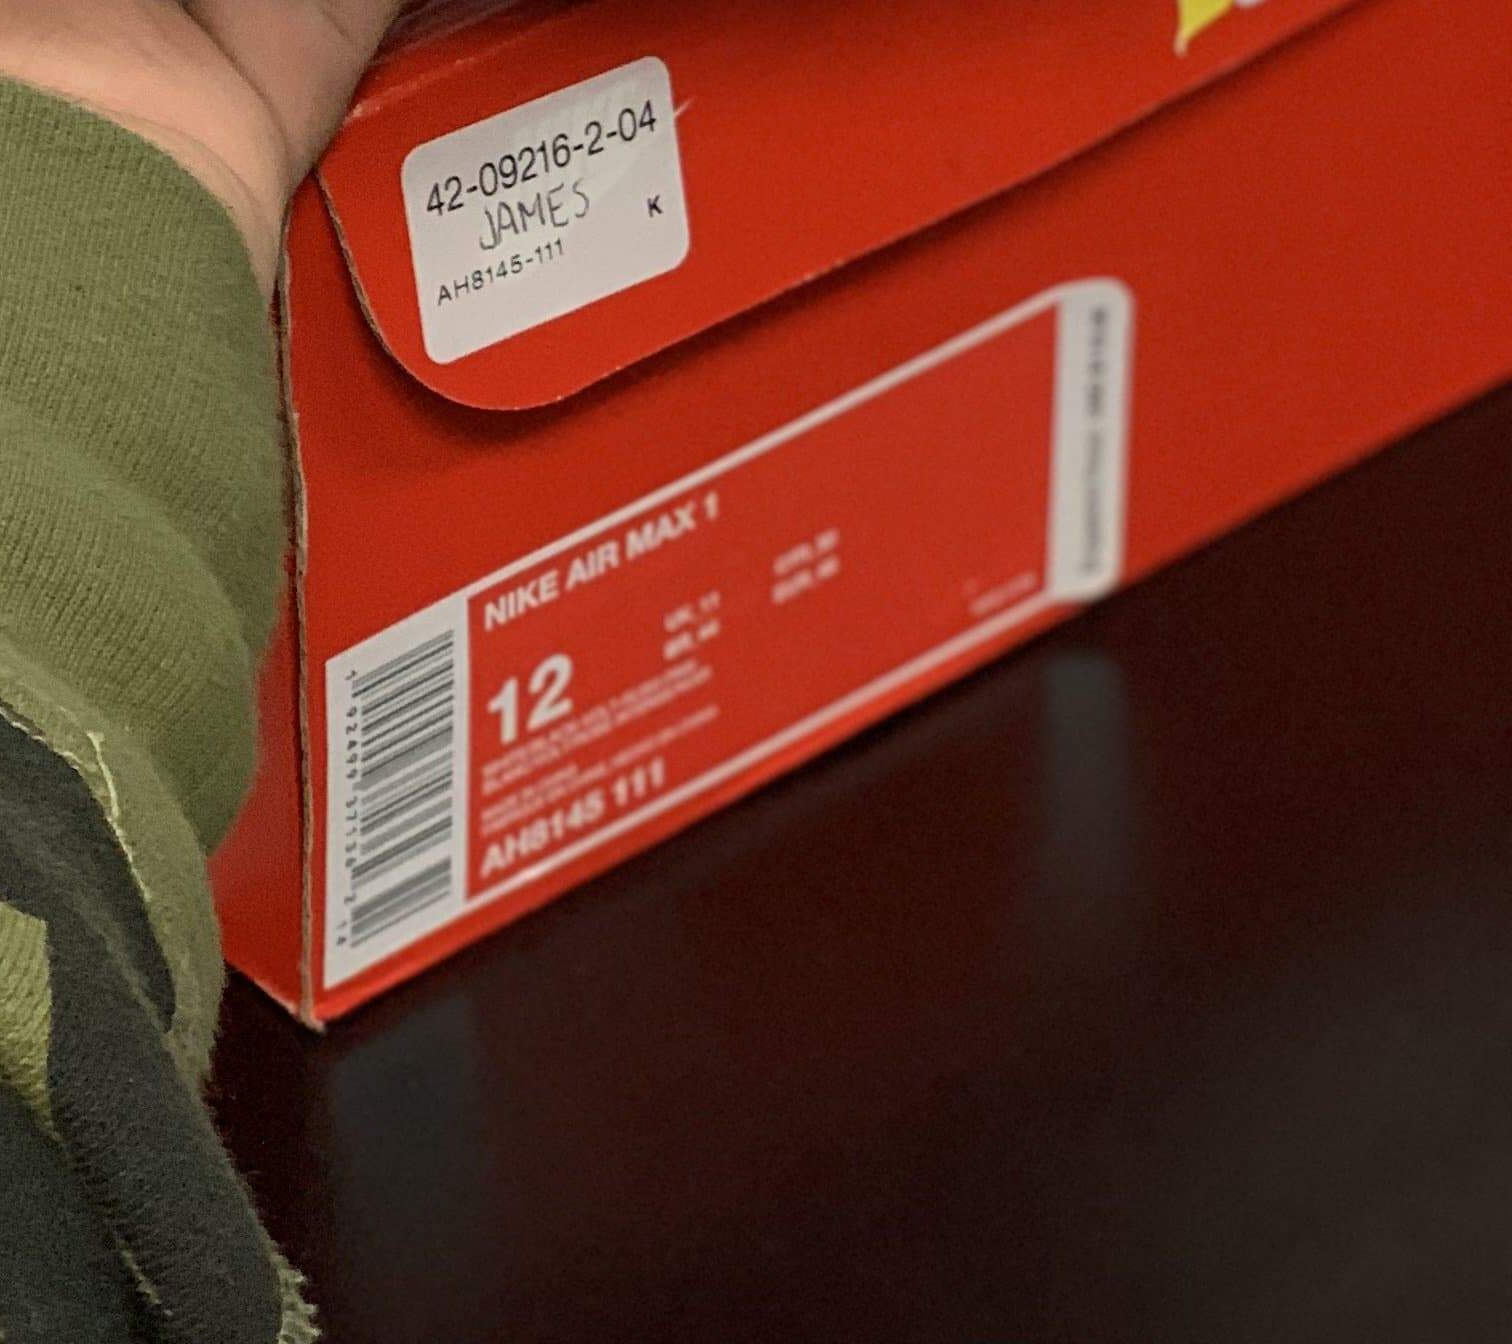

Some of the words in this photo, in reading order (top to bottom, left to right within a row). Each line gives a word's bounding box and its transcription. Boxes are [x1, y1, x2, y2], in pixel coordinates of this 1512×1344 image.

[426, 99, 658, 216] 42-09216-2-04
[478, 178, 591, 251] JAMES
[646, 194, 664, 218] K
[437, 239, 566, 307] AH8145-111
[484, 569, 559, 632] NIKE
[565, 540, 621, 592] AIR
[625, 501, 697, 561] MAX
[703, 490, 719, 521] 1
[488, 653, 574, 744] 12
[479, 788, 606, 879] AH8145
[612, 756, 666, 807] 111
